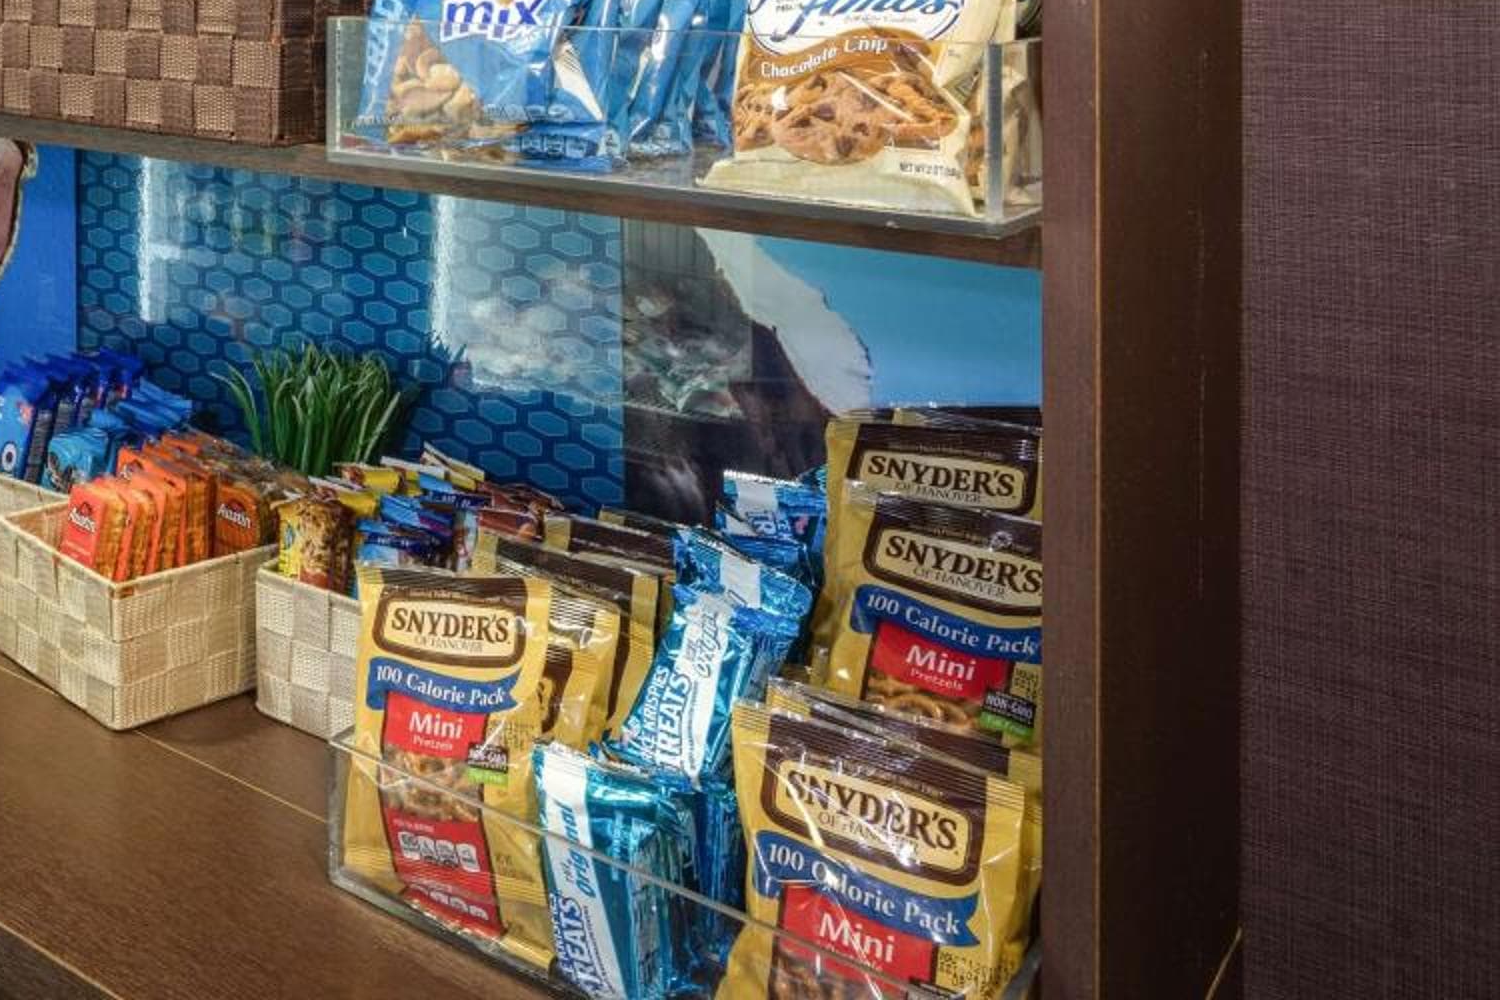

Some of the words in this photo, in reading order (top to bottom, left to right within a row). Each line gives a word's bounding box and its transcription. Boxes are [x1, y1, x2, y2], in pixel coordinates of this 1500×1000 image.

[760, 45, 838, 79] Chocolate
[843, 35, 888, 54] Chip
[867, 455, 1016, 498] SNYDER'S
[217, 503, 251, 529] Austin
[885, 534, 1042, 595] SNYDER'S
[932, 571, 1007, 598] HANOVER
[391, 606, 511, 645] SNYDER'S
[867, 593, 900, 616] 100
[905, 606, 980, 648] Calorie
[987, 633, 1038, 655] Pack
[905, 644, 977, 682] Mini
[910, 667, 964, 691] Pretzels
[376, 665, 402, 684] 100
[406, 674, 465, 706] Calorie
[469, 687, 506, 708] Pack
[643, 665, 670, 732] KRISPIES
[408, 711, 464, 740] Mini
[656, 671, 693, 771] TREATS
[785, 769, 959, 852] SNYDER'S
[553, 797, 597, 899] orignal
[768, 842, 804, 872] 100
[904, 901, 961, 937] Pack
[818, 912, 896, 965] Mini
